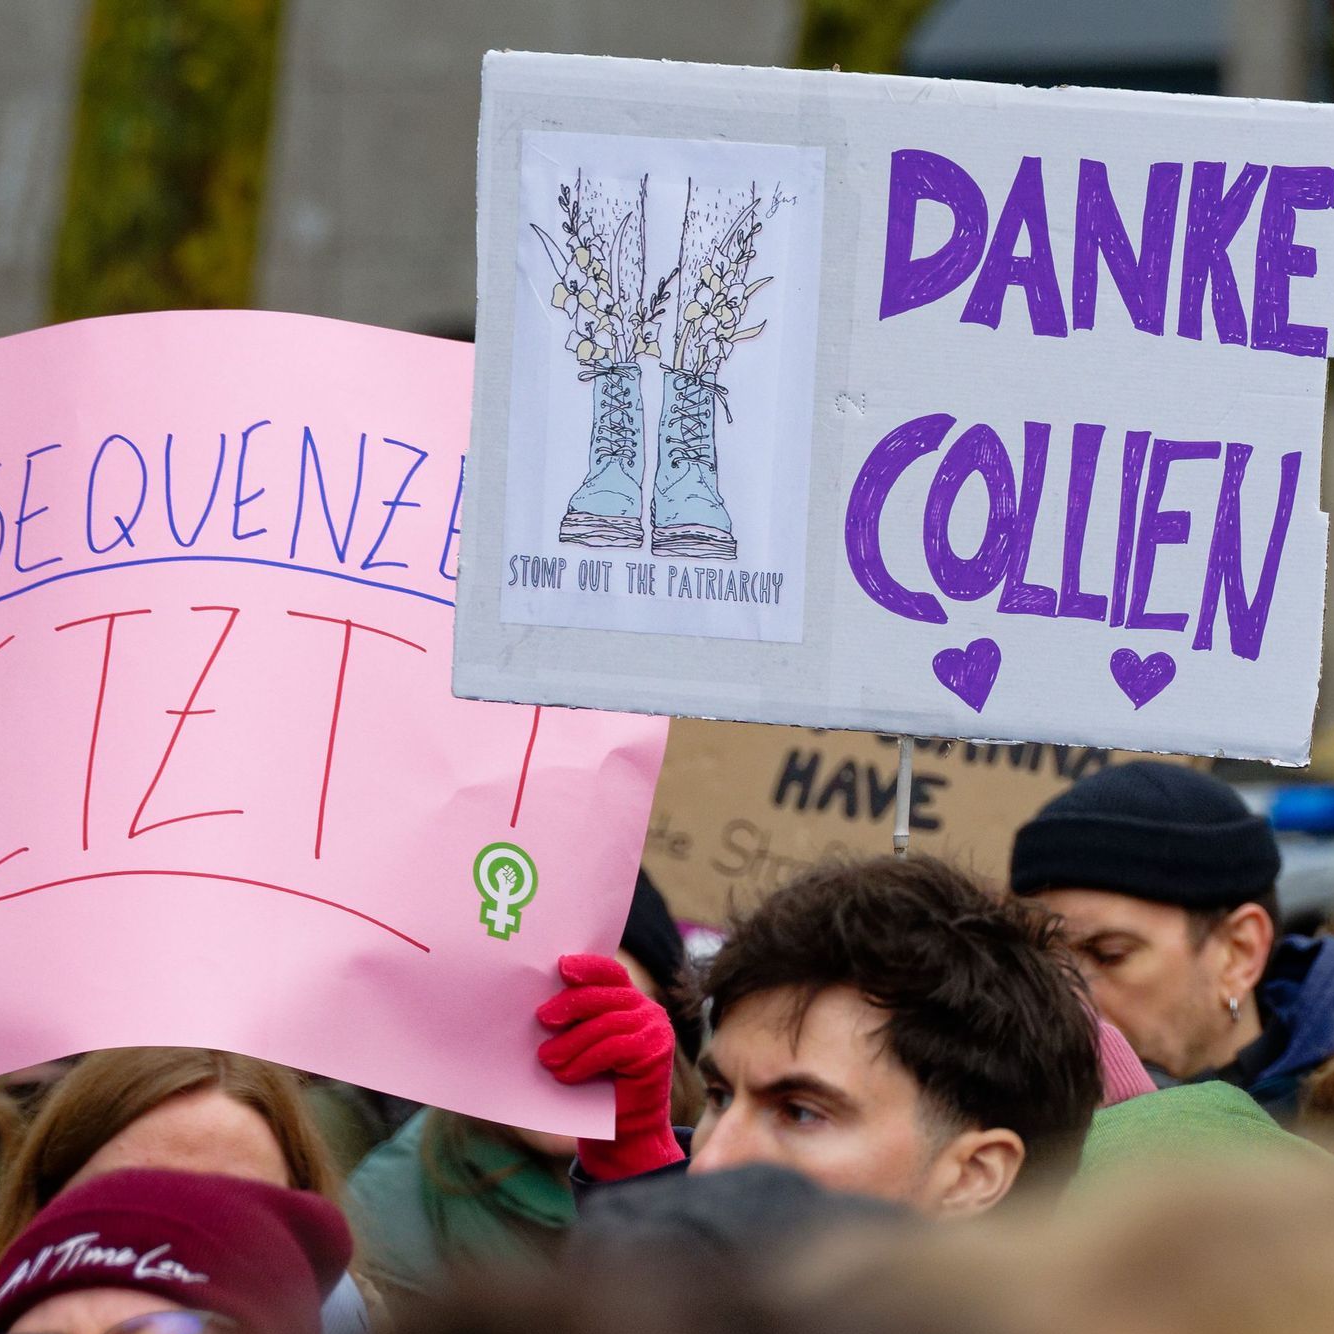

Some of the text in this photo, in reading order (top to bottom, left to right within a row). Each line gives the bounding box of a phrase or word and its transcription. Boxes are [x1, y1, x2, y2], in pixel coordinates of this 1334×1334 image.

[844, 413, 1303, 660] COLLIEN
[508, 554, 784, 604] STOMP OUT THE PATRIARCHY
[773, 748, 949, 831] HAVE
[48, 1232, 139, 1281] Time
